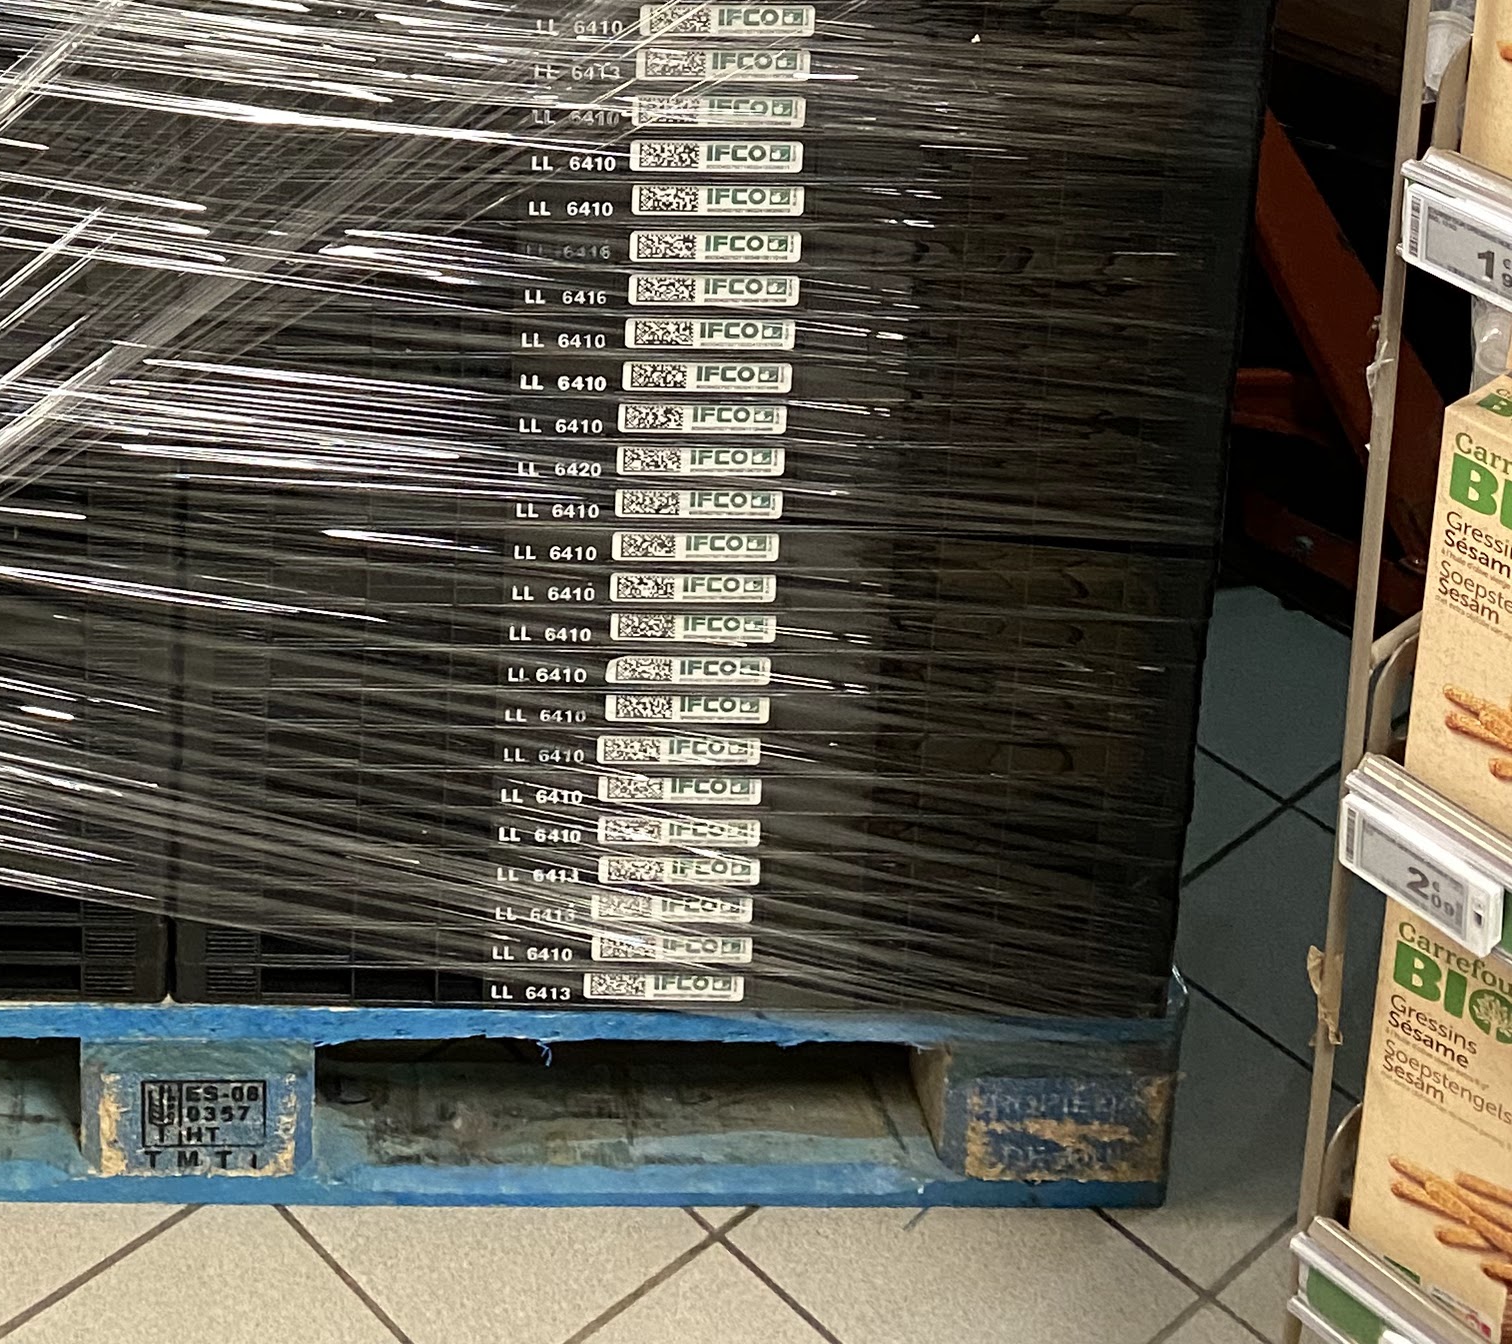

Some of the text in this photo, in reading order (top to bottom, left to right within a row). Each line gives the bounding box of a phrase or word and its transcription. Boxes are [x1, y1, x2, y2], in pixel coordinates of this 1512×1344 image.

[529, 187, 765, 217] LL 6410 IFCO
[525, 277, 762, 305] LL 6416 IFCO
[520, 365, 755, 391] LL 6410 IFCO
[517, 449, 747, 477] LL 6420 IFCO
[514, 535, 743, 561] LL 6410 IFCO
[1444, 529, 1512, 579] Sésam
[1438, 577, 1499, 624] Sesam
[1440, 560, 1512, 615] Soepste
[1399, 921, 1512, 996] Carrefou
[491, 975, 708, 1000] LL 6413 IFCO
[1388, 1010, 1469, 1069] Sésame
[1391, 994, 1478, 1055] Gressins
[1383, 1055, 1445, 1103] Sesam
[1385, 1039, 1512, 1126] Soepstengels
[187, 1127, 220, 1143] HT
